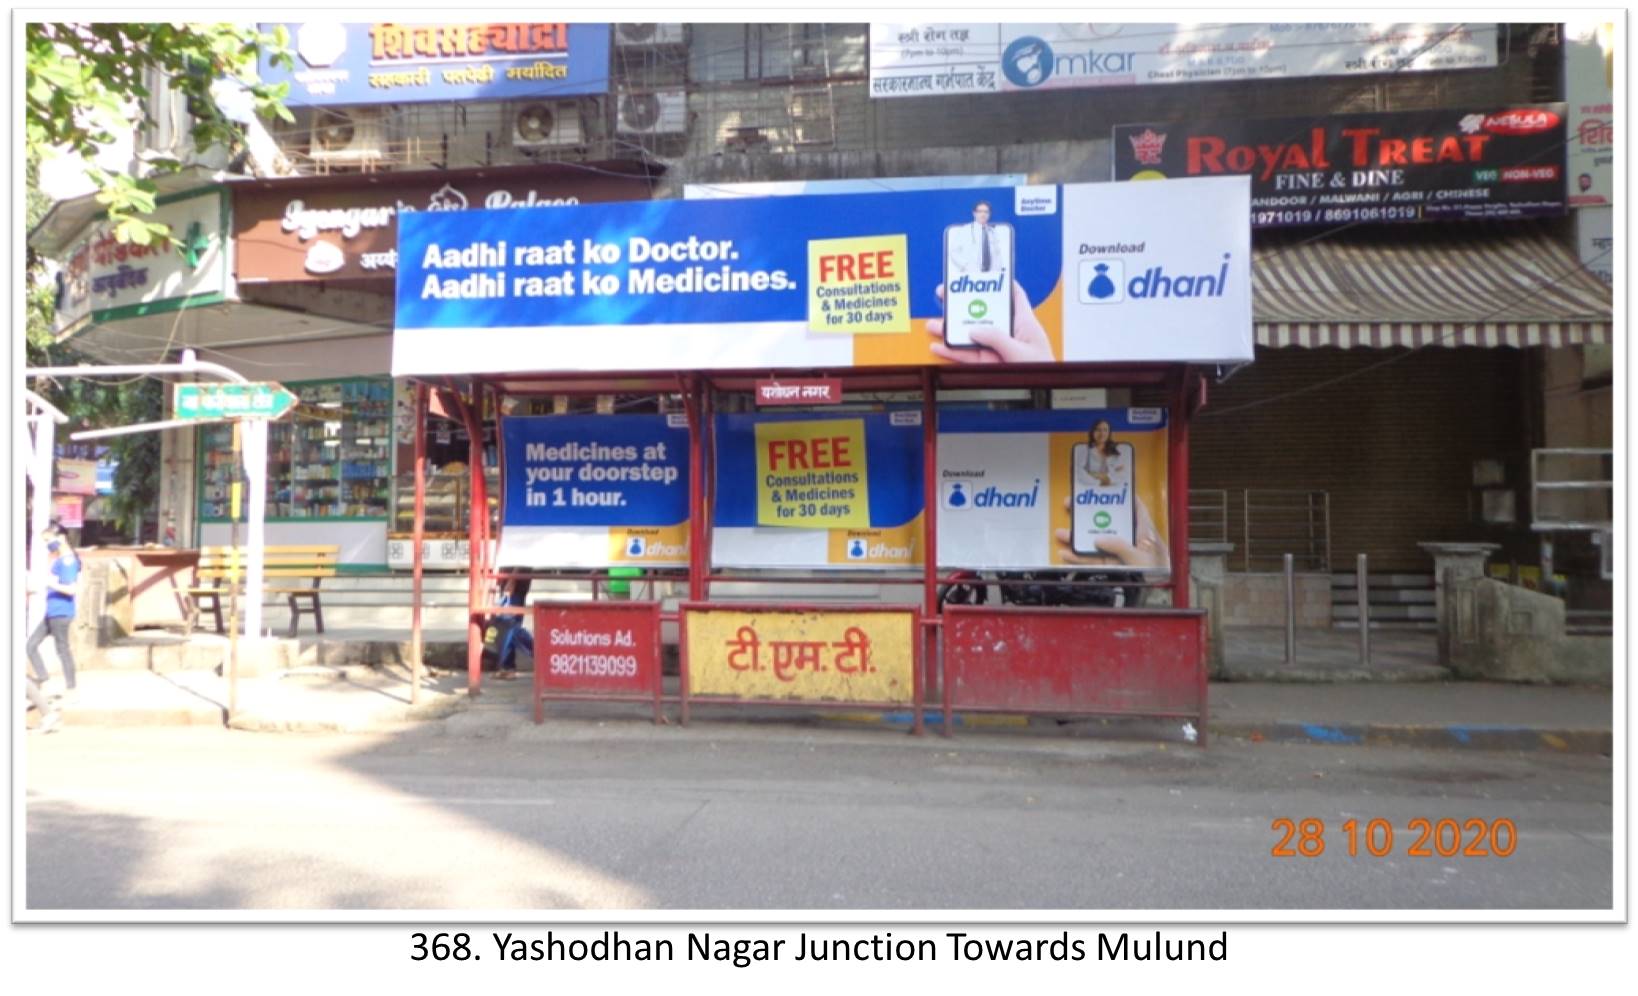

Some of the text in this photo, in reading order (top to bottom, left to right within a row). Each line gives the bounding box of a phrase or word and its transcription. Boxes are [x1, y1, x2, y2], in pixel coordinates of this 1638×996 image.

[1276, 169, 1404, 189] FINE & DINE
[1476, 171, 1497, 181] VEG
[1503, 169, 1554, 180] NON-VEG
[1319, 191, 1380, 204] MALWANI
[1392, 190, 1424, 201] AGRI
[1435, 188, 1491, 200] CHINESE
[422, 236, 738, 268] Aadhi raat ko Doctor.
[1079, 241, 1146, 255] Download
[819, 250, 895, 283] FREE
[1128, 252, 1231, 299] dhani
[421, 265, 797, 300] Aadhi raat ko Medicines.
[816, 281, 901, 298] Consultations
[950, 267, 1007, 294] dhani
[821, 296, 898, 312] & Medicines
[826, 310, 893, 325] for 30 days
[526, 442, 666, 461] Medicines at
[768, 436, 851, 471] FREE
[526, 463, 678, 485] your doorstep
[766, 471, 859, 489] Consultations
[526, 487, 627, 506] in 1 hour.
[772, 487, 855, 502] & Medicines
[974, 478, 1040, 507] dhani
[1076, 482, 1128, 505] dhani
[777, 502, 850, 518] for 30 days
[550, 628, 635, 648] Solutions Ad.
[725, 626, 877, 682] टी. एम. टी.
[550, 655, 637, 677] 9821139099
